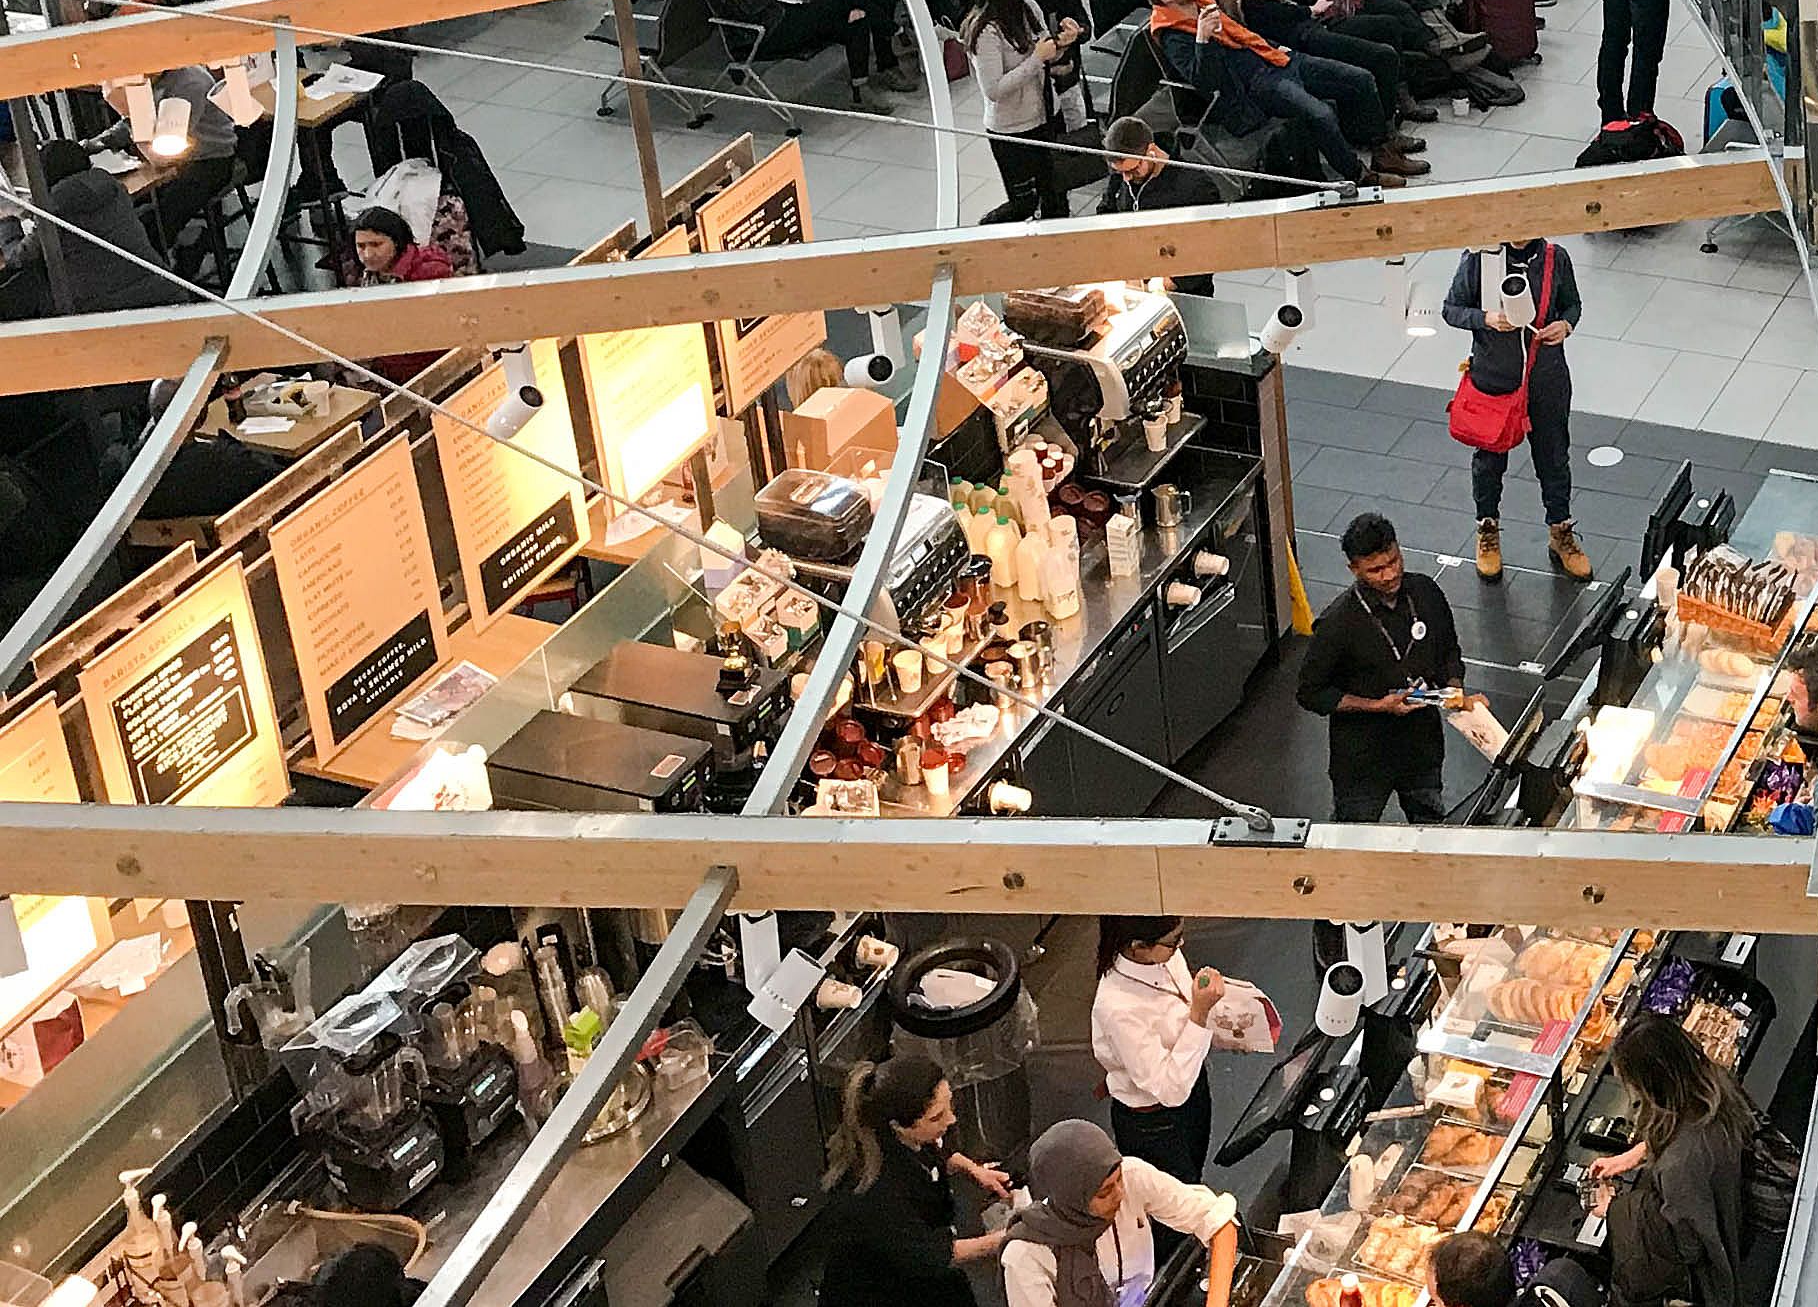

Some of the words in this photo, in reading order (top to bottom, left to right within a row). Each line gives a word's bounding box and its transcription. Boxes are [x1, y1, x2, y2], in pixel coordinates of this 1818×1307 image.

[499, 533, 534, 566] ORGANIC
[536, 516, 555, 535] MILK
[336, 693, 357, 715] SOYA
[368, 654, 405, 688] SKIMMED
[407, 636, 426, 656] MILK
